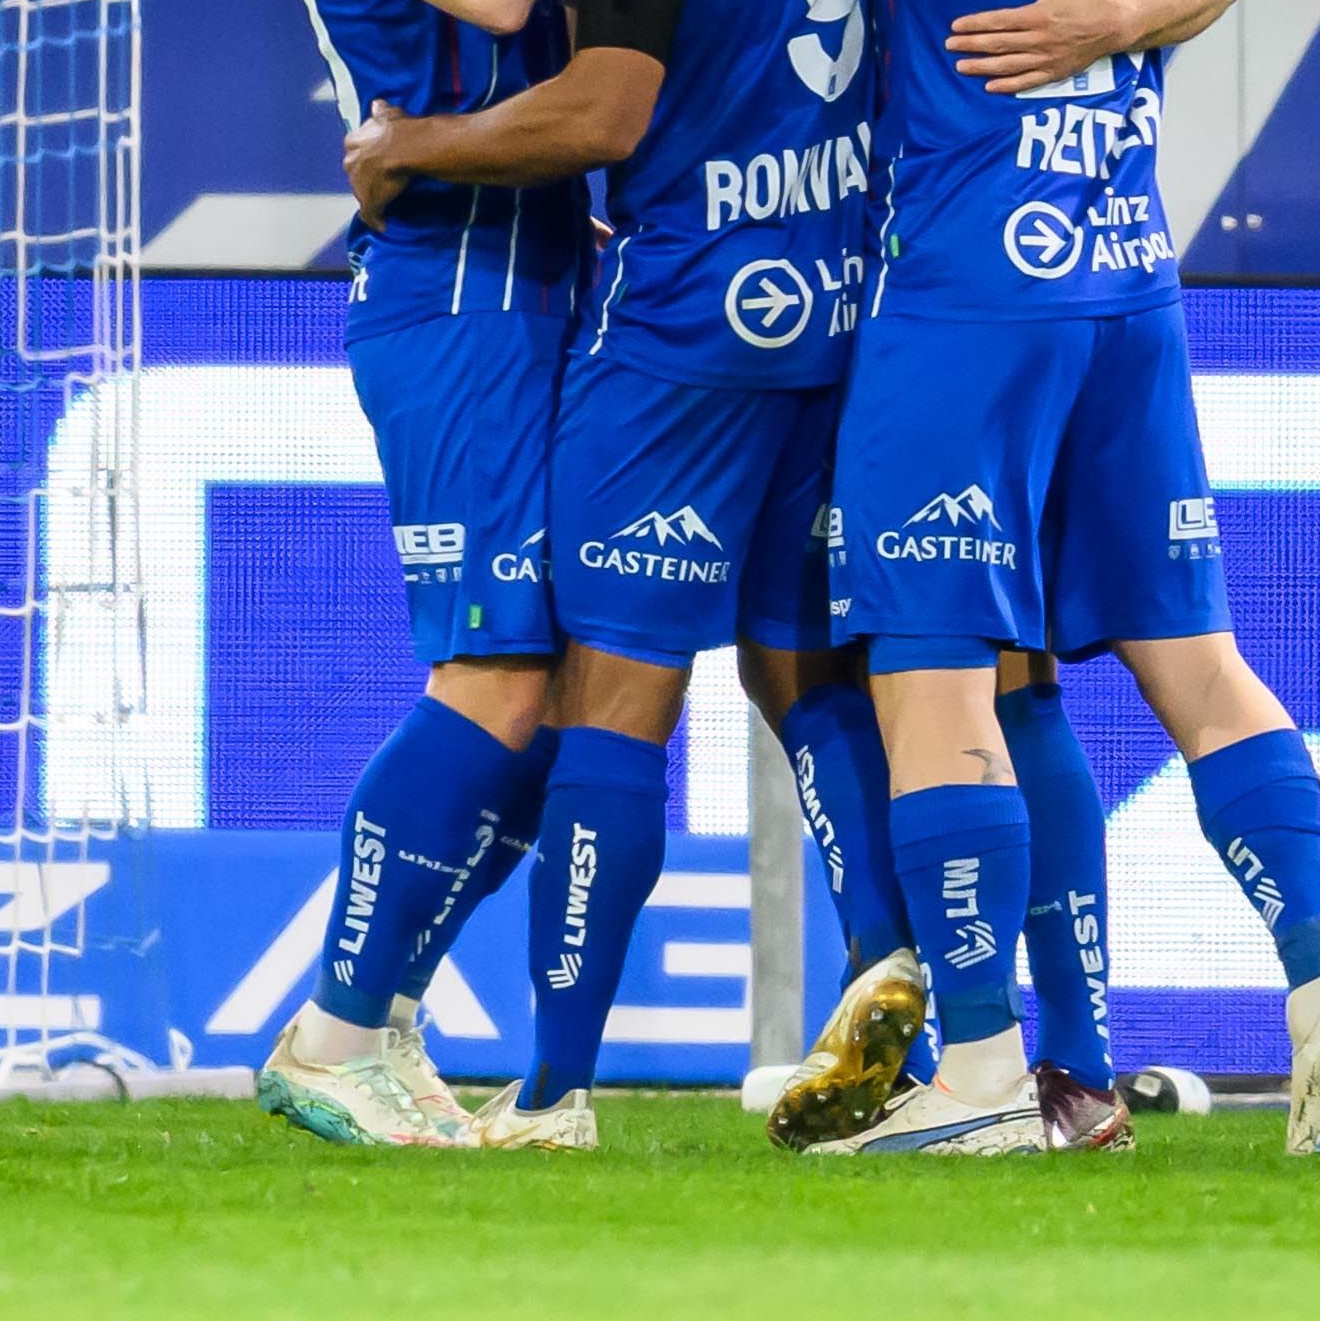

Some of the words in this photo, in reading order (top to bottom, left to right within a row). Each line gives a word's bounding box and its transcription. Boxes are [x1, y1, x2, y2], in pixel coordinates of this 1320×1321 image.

[1087, 187, 1149, 226] Linz
[579, 541, 730, 584] GASTEINER
[877, 531, 1016, 571] GASTEINER
[339, 811, 387, 955] LIWEST
[563, 822, 598, 947] LIWEST
